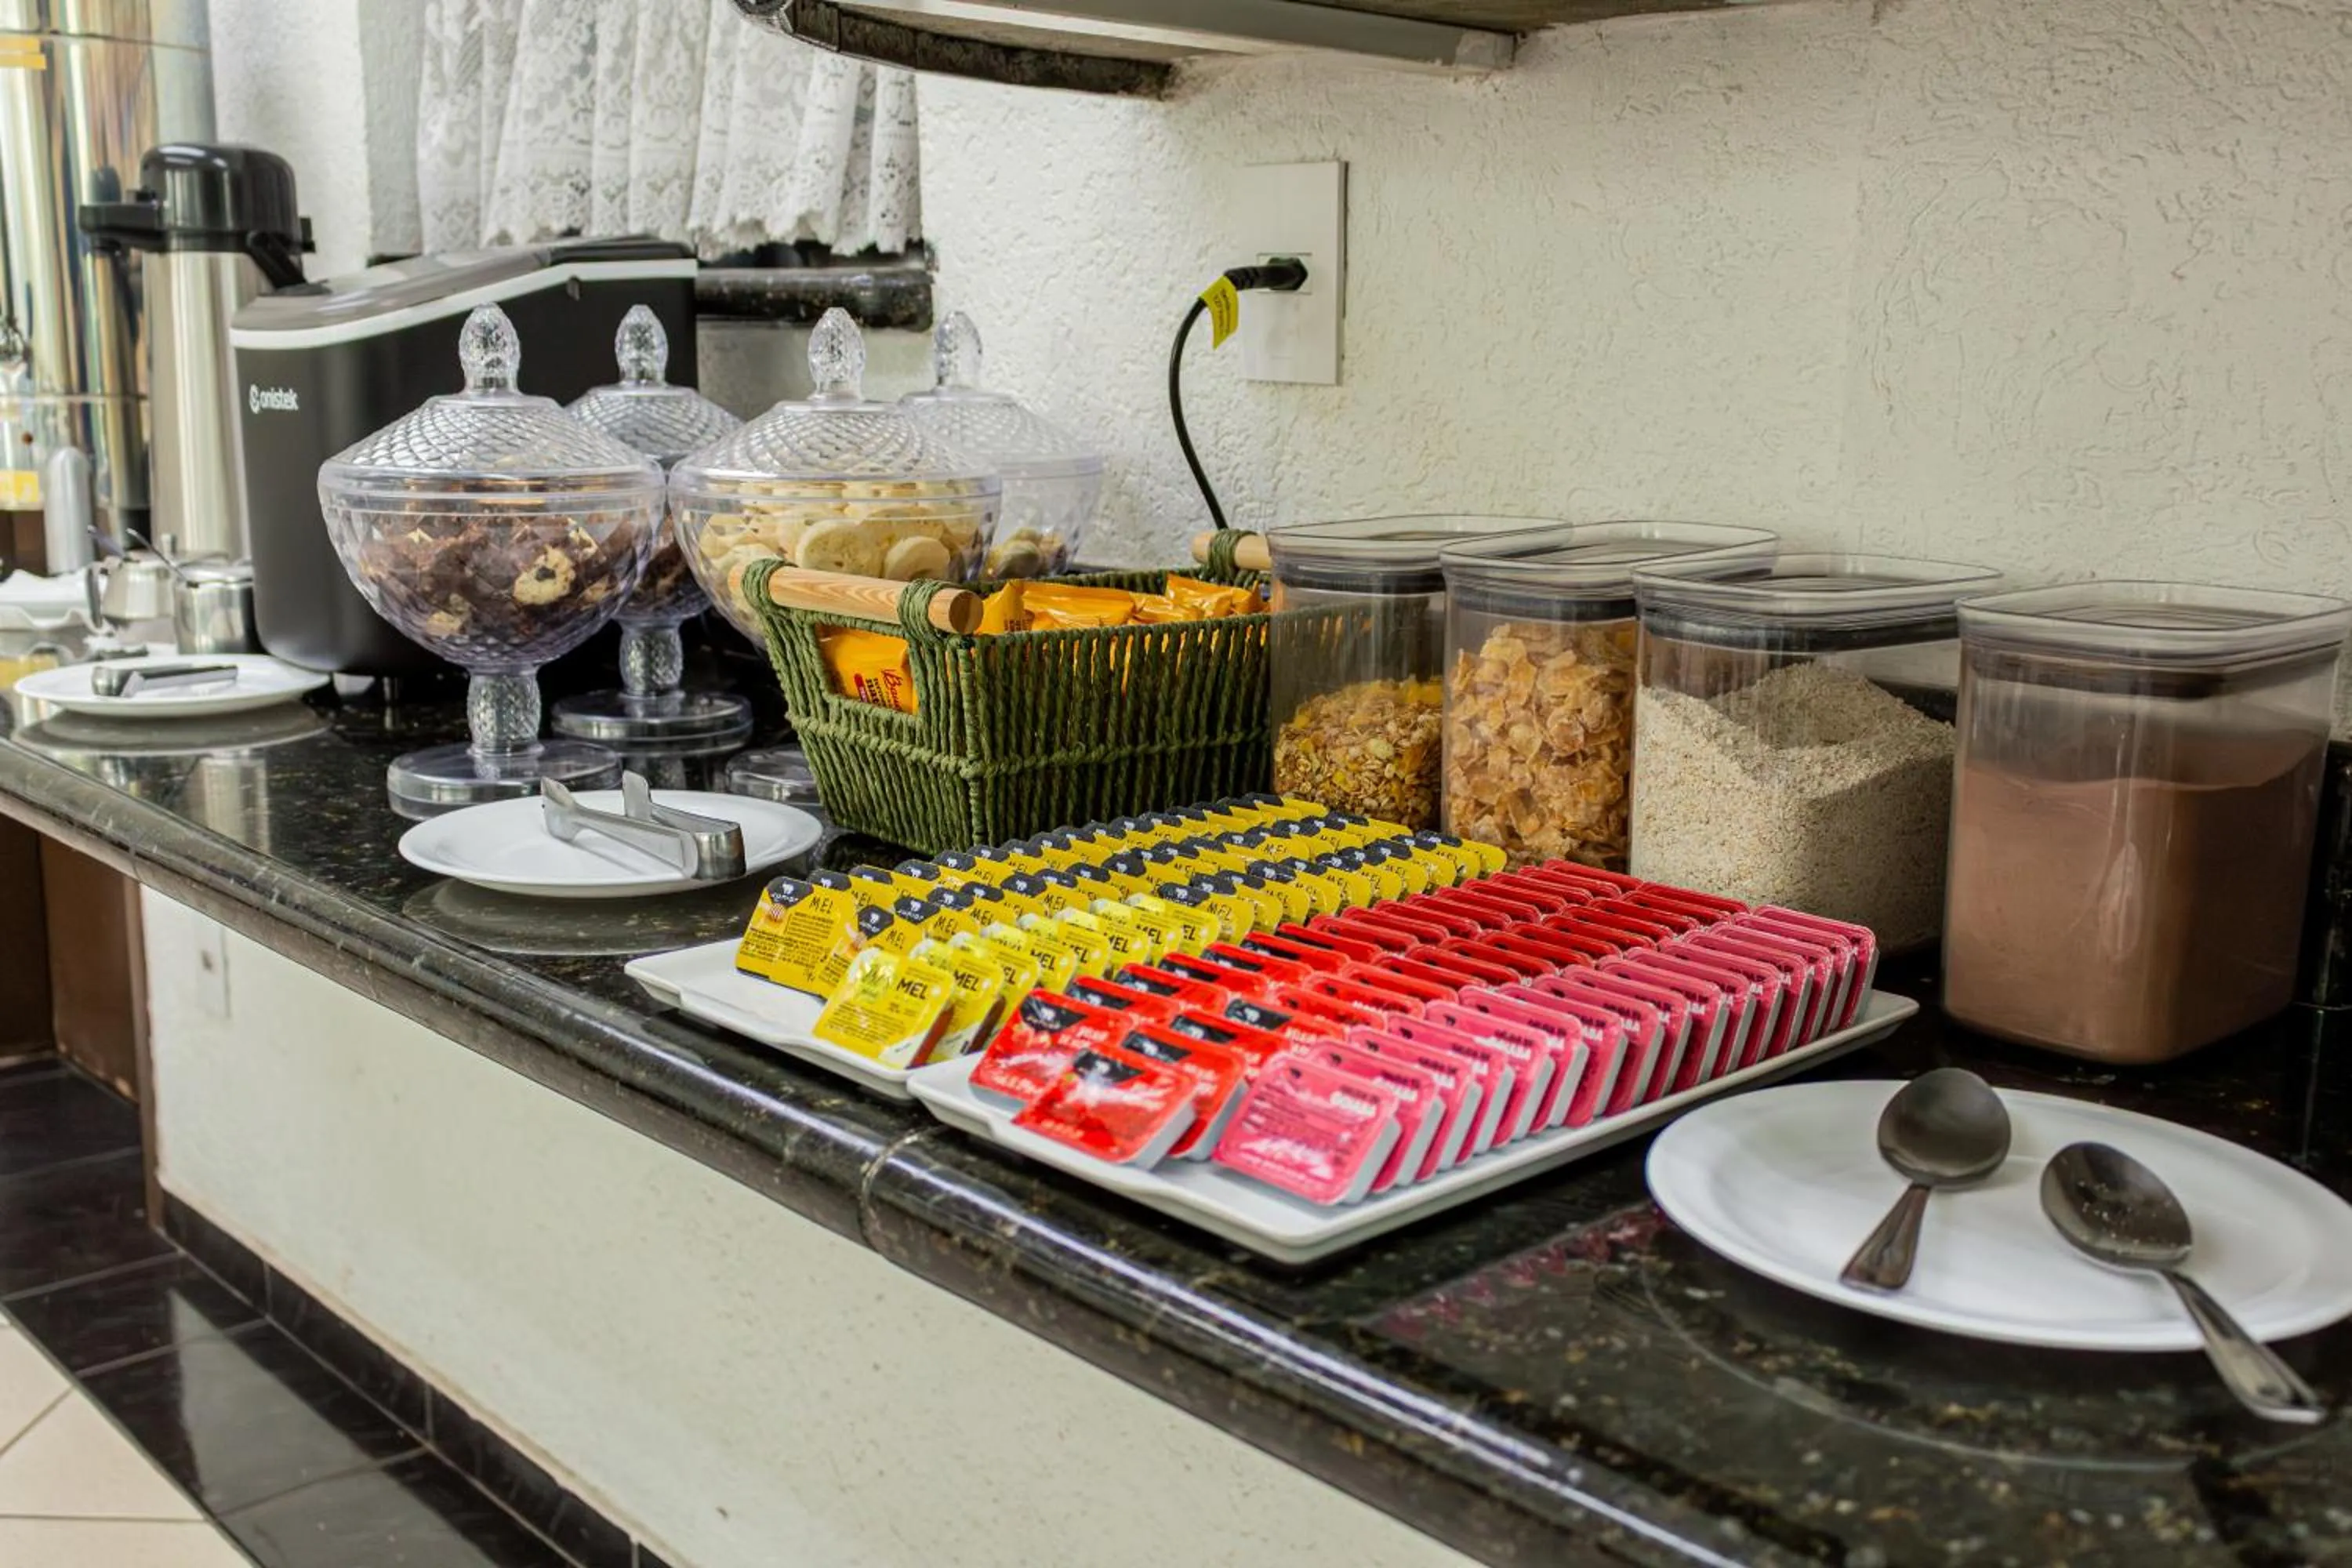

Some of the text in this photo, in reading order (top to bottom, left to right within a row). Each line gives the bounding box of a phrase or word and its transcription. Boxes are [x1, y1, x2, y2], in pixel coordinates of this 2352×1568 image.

[809, 896, 833, 915] MEL
[934, 916, 958, 935] MEL
[896, 978, 928, 1000] MEL
